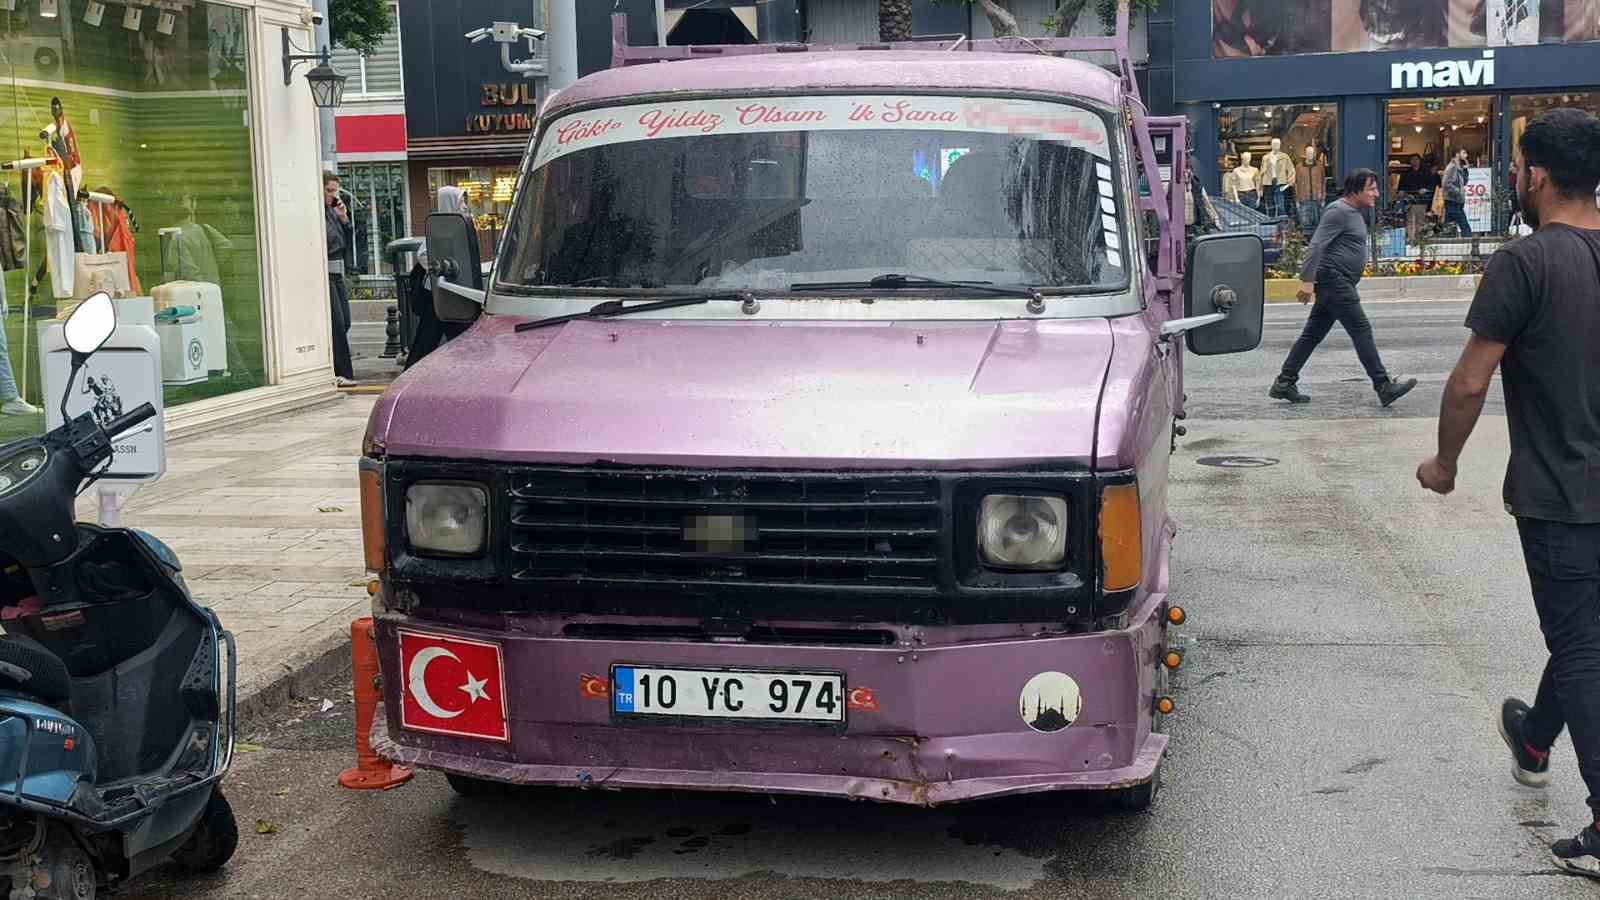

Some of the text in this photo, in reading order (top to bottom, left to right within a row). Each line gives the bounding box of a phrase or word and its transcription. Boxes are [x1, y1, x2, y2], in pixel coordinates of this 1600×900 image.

[1391, 49, 1495, 89] mavi
[735, 103, 827, 126] Olsam
[881, 100, 957, 123] Sana
[619, 691, 634, 704] TR
[639, 673, 837, 714] 10 YC 974
